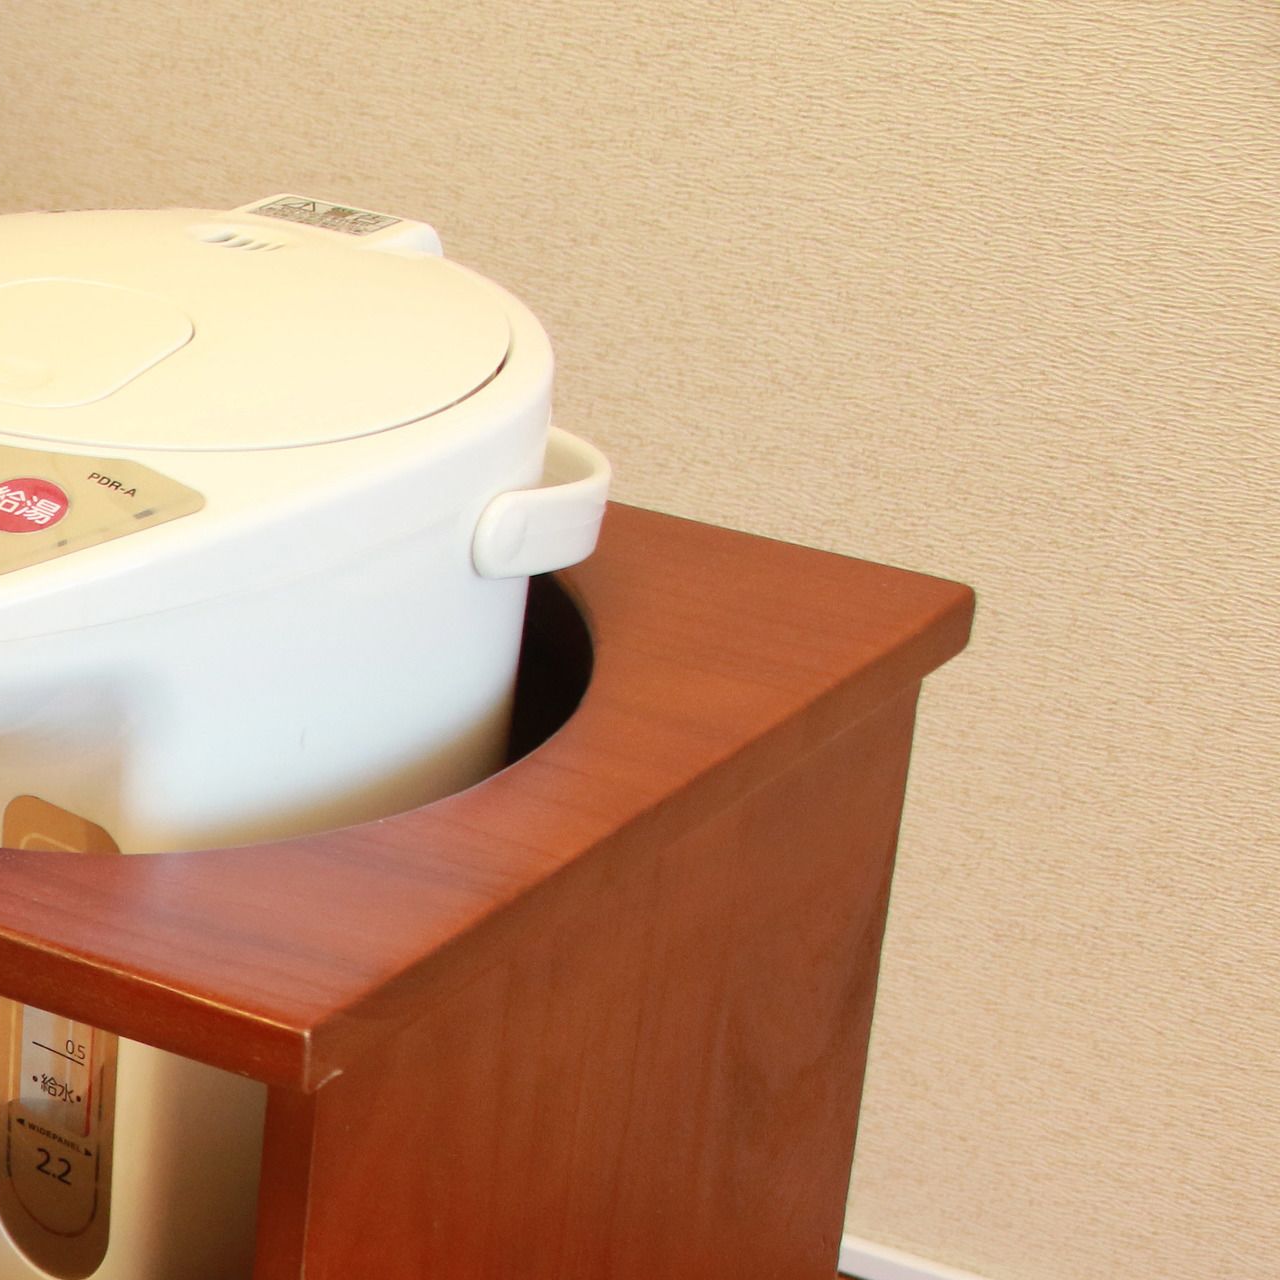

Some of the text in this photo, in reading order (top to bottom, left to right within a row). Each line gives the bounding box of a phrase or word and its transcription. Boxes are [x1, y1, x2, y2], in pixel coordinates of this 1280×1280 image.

[88, 472, 137, 497] PDR-A
[66, 1039, 86, 1060] 0.5
[40, 1073, 74, 1104] 給水
[36, 1147, 72, 1186] 2.2
